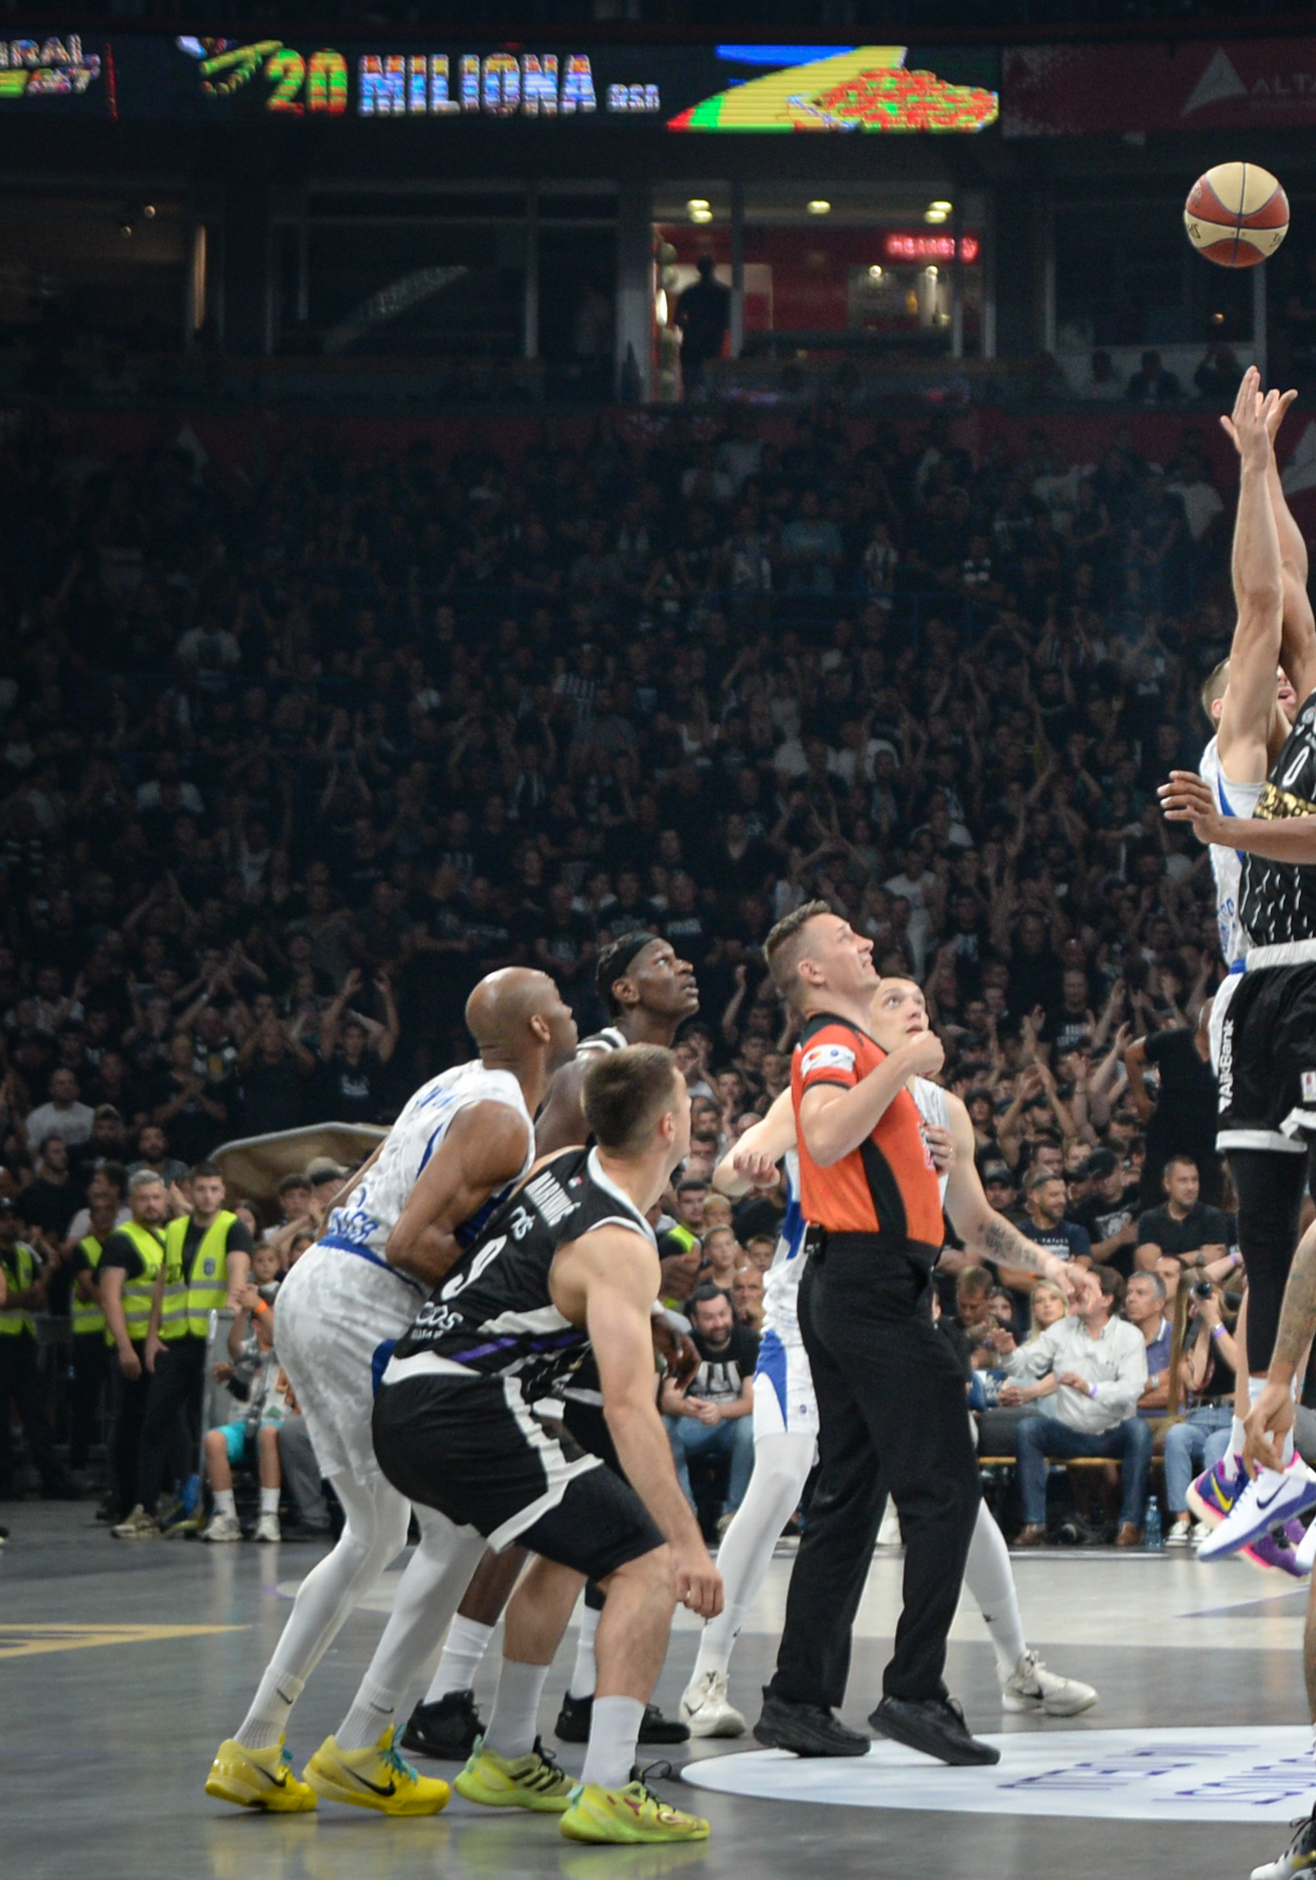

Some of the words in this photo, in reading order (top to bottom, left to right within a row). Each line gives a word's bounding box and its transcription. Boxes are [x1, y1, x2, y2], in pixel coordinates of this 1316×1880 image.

[266, 48, 348, 114] 20
[358, 53, 597, 117] MILIONA
[441, 1235, 507, 1300] 9
